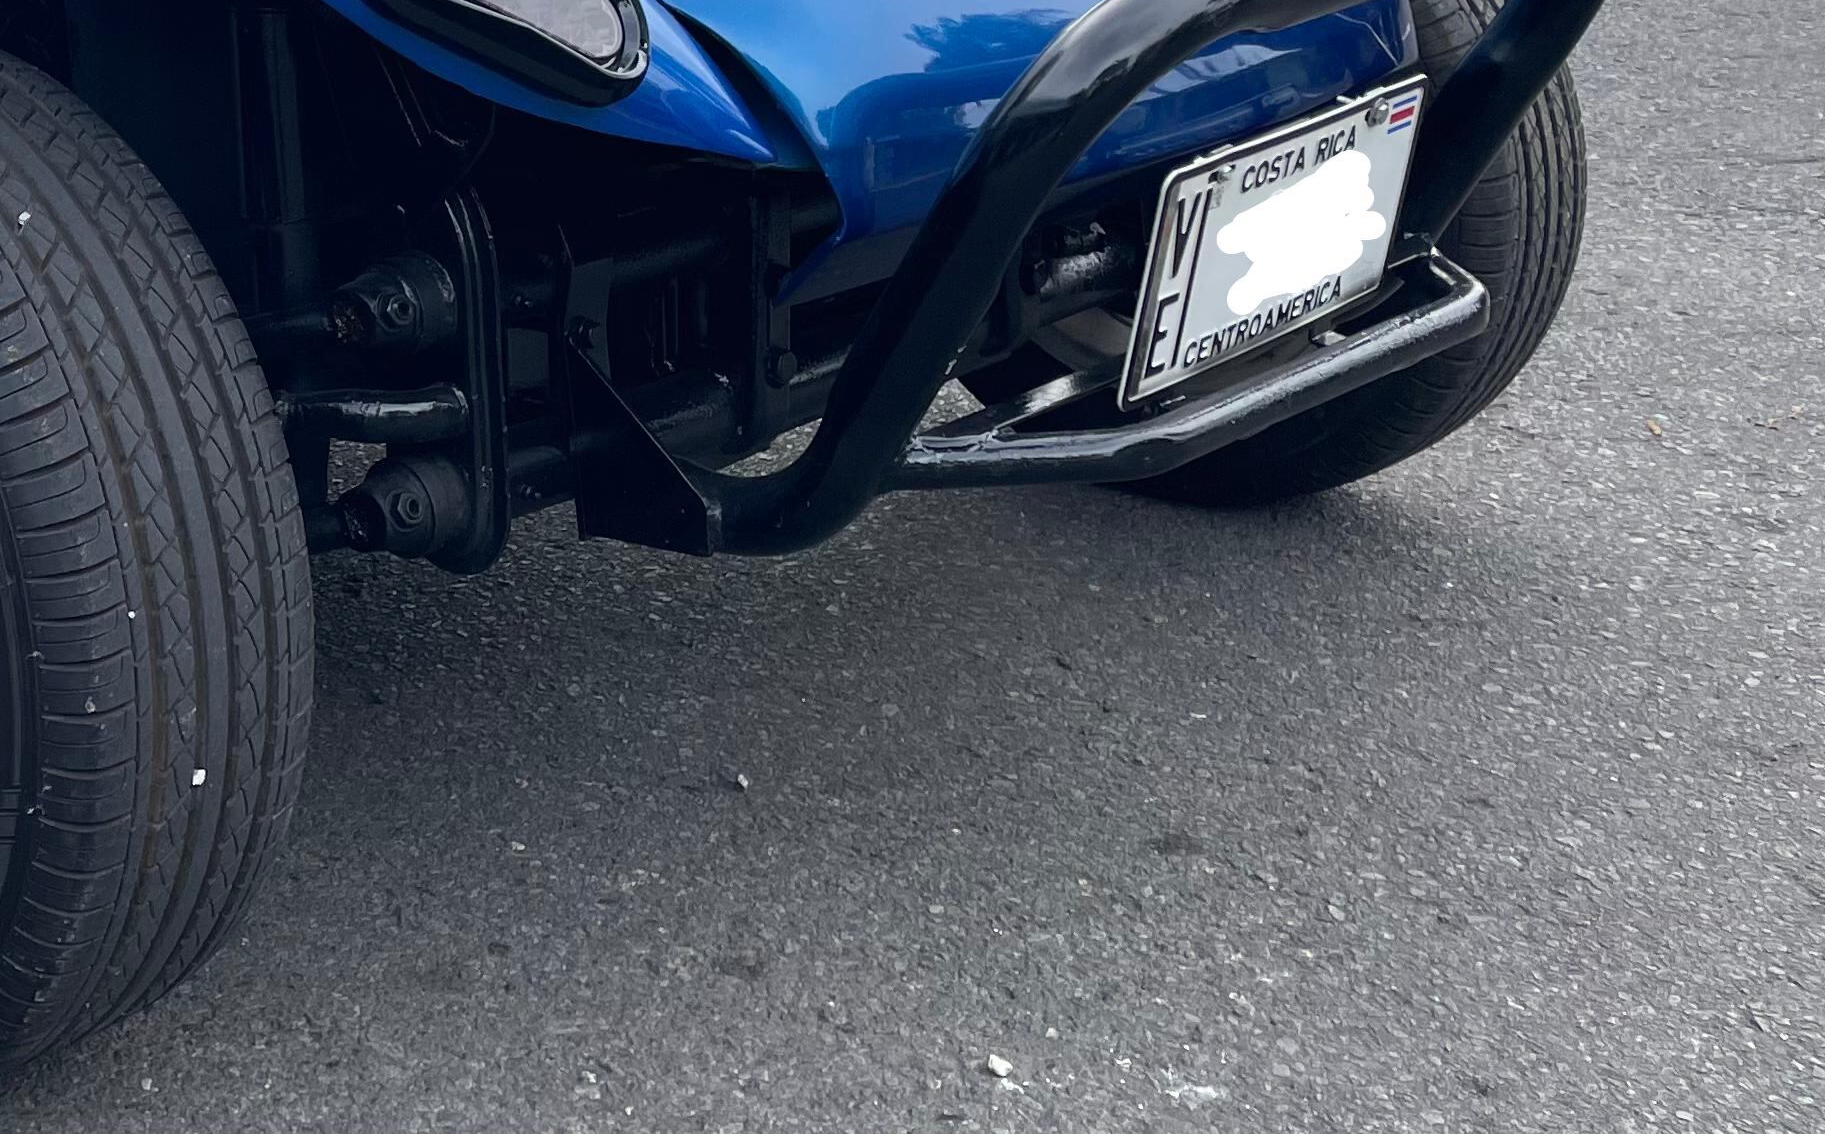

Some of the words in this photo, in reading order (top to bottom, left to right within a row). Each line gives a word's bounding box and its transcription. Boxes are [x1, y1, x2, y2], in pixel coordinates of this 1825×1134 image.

[1241, 146, 1305, 194] COSTA
[1314, 124, 1356, 166] RICA
[1184, 275, 1342, 368] CENTROAMERICA
